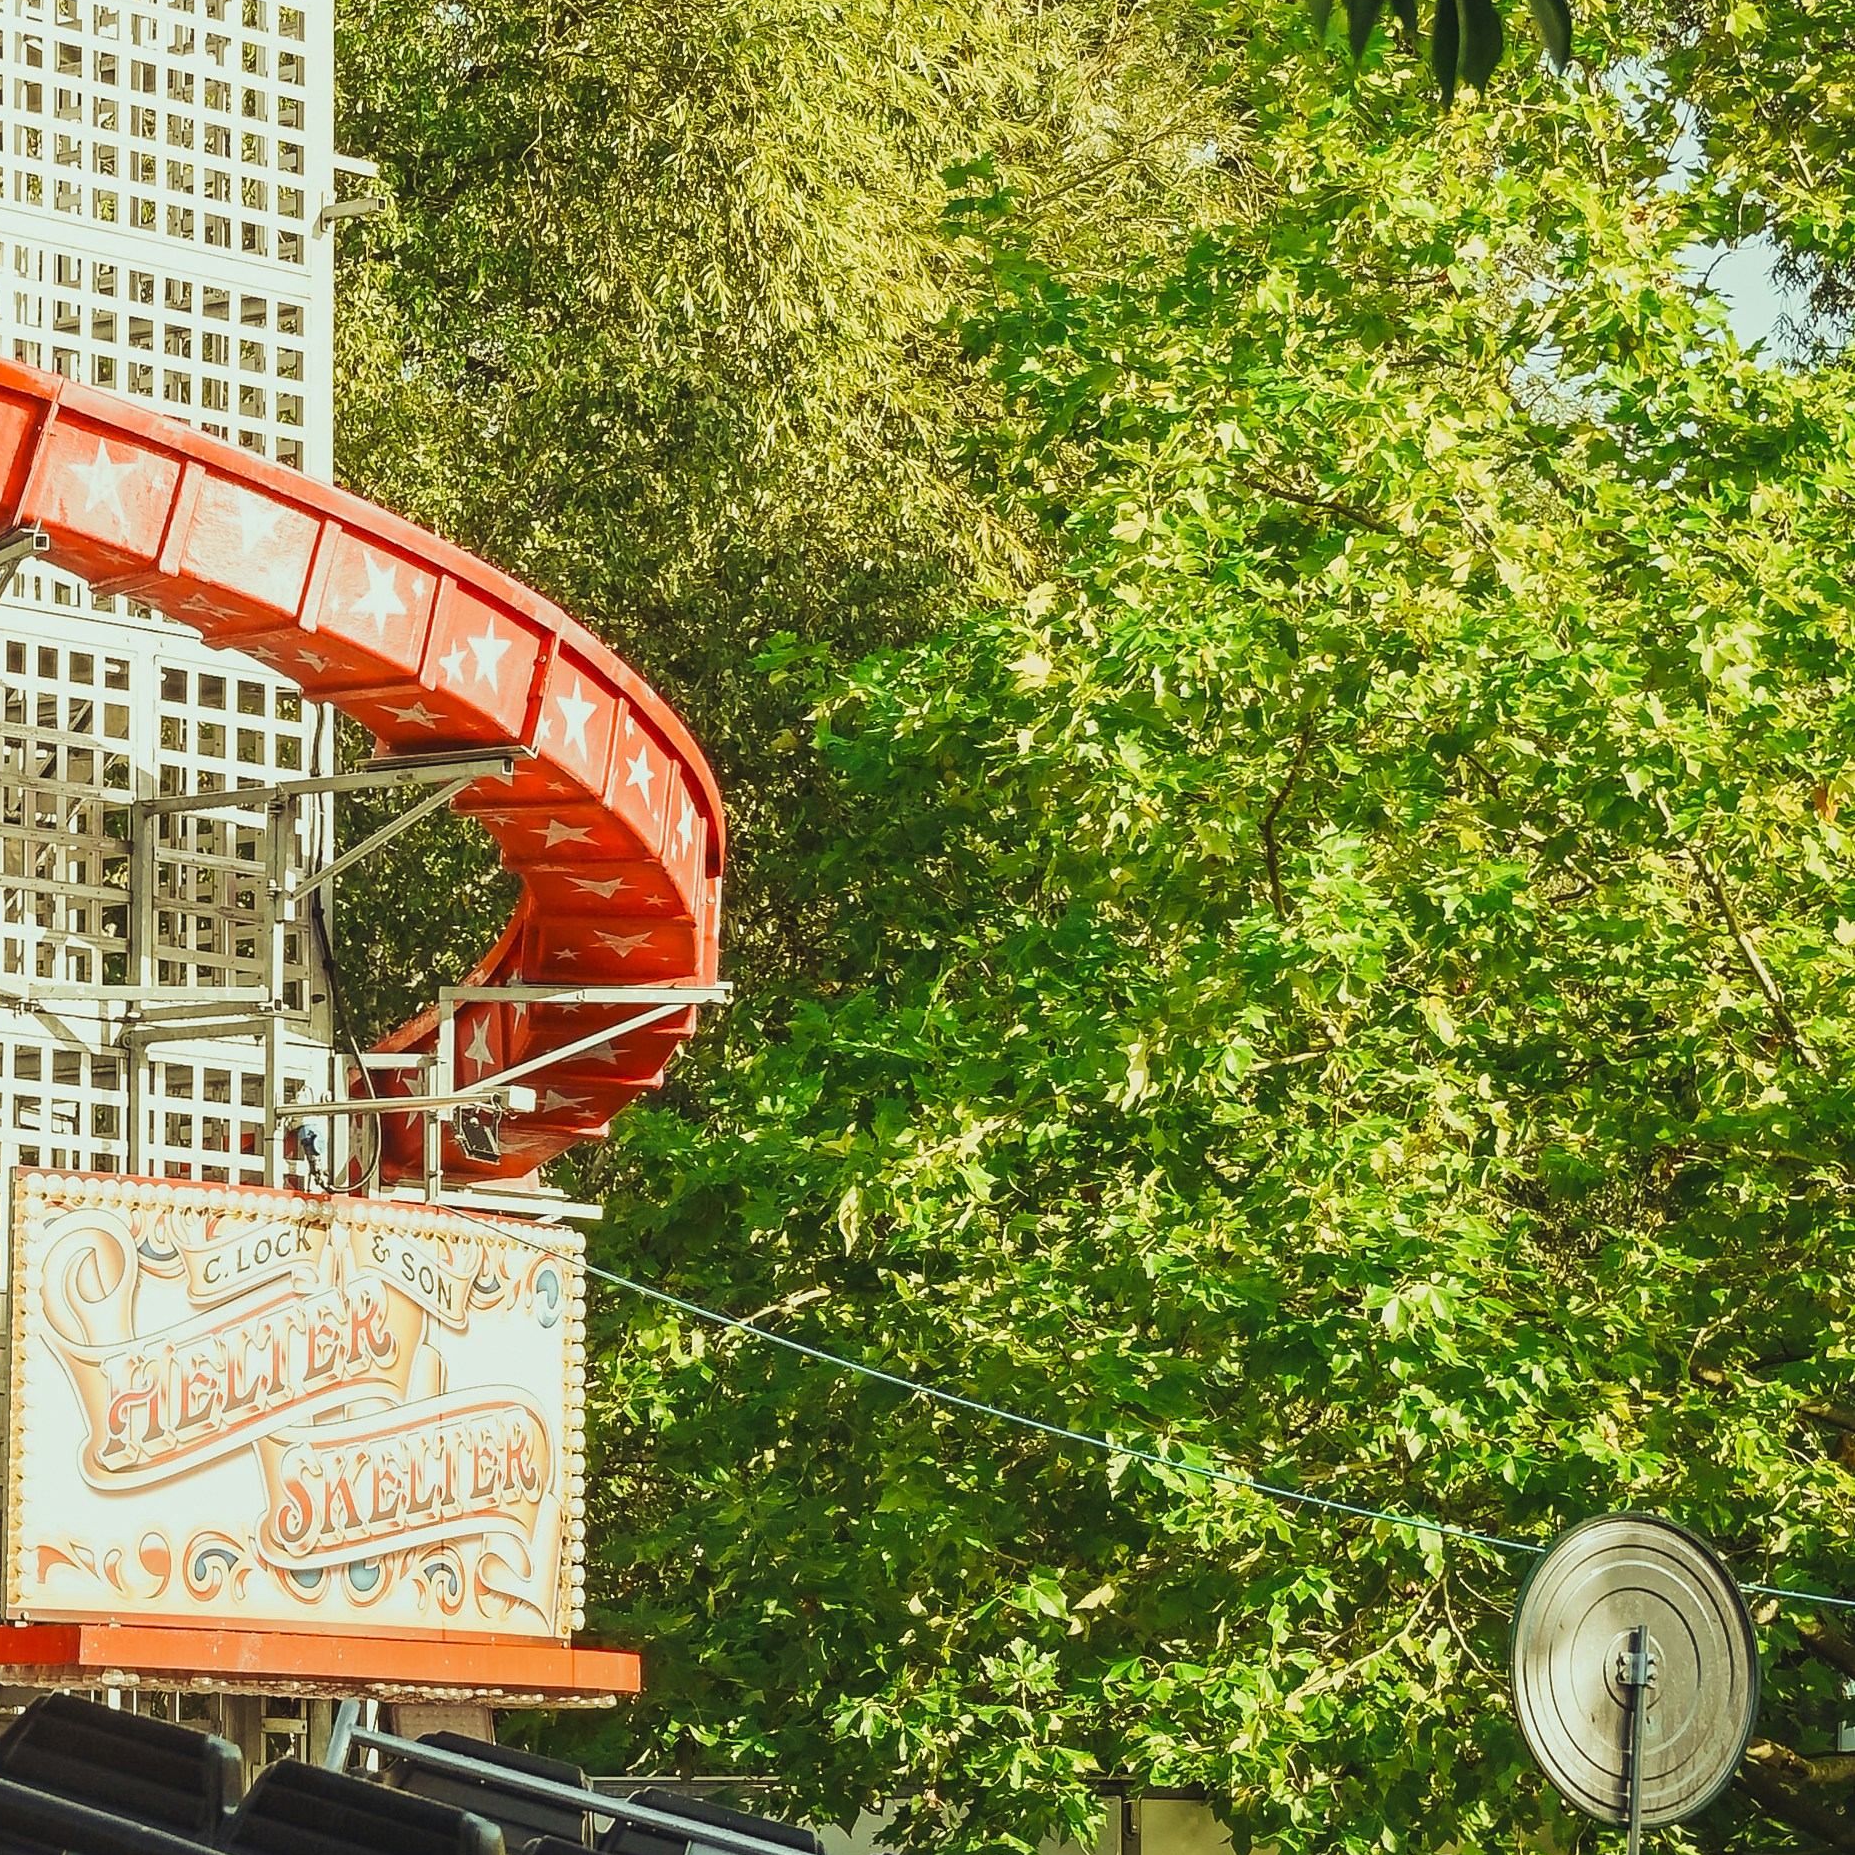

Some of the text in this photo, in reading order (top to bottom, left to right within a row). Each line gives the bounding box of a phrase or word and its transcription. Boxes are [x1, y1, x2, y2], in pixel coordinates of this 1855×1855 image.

[203, 1220, 453, 1311] C. LOCK & SON
[100, 1280, 398, 1466] HELTER
[274, 1408, 543, 1558] SKELTER
